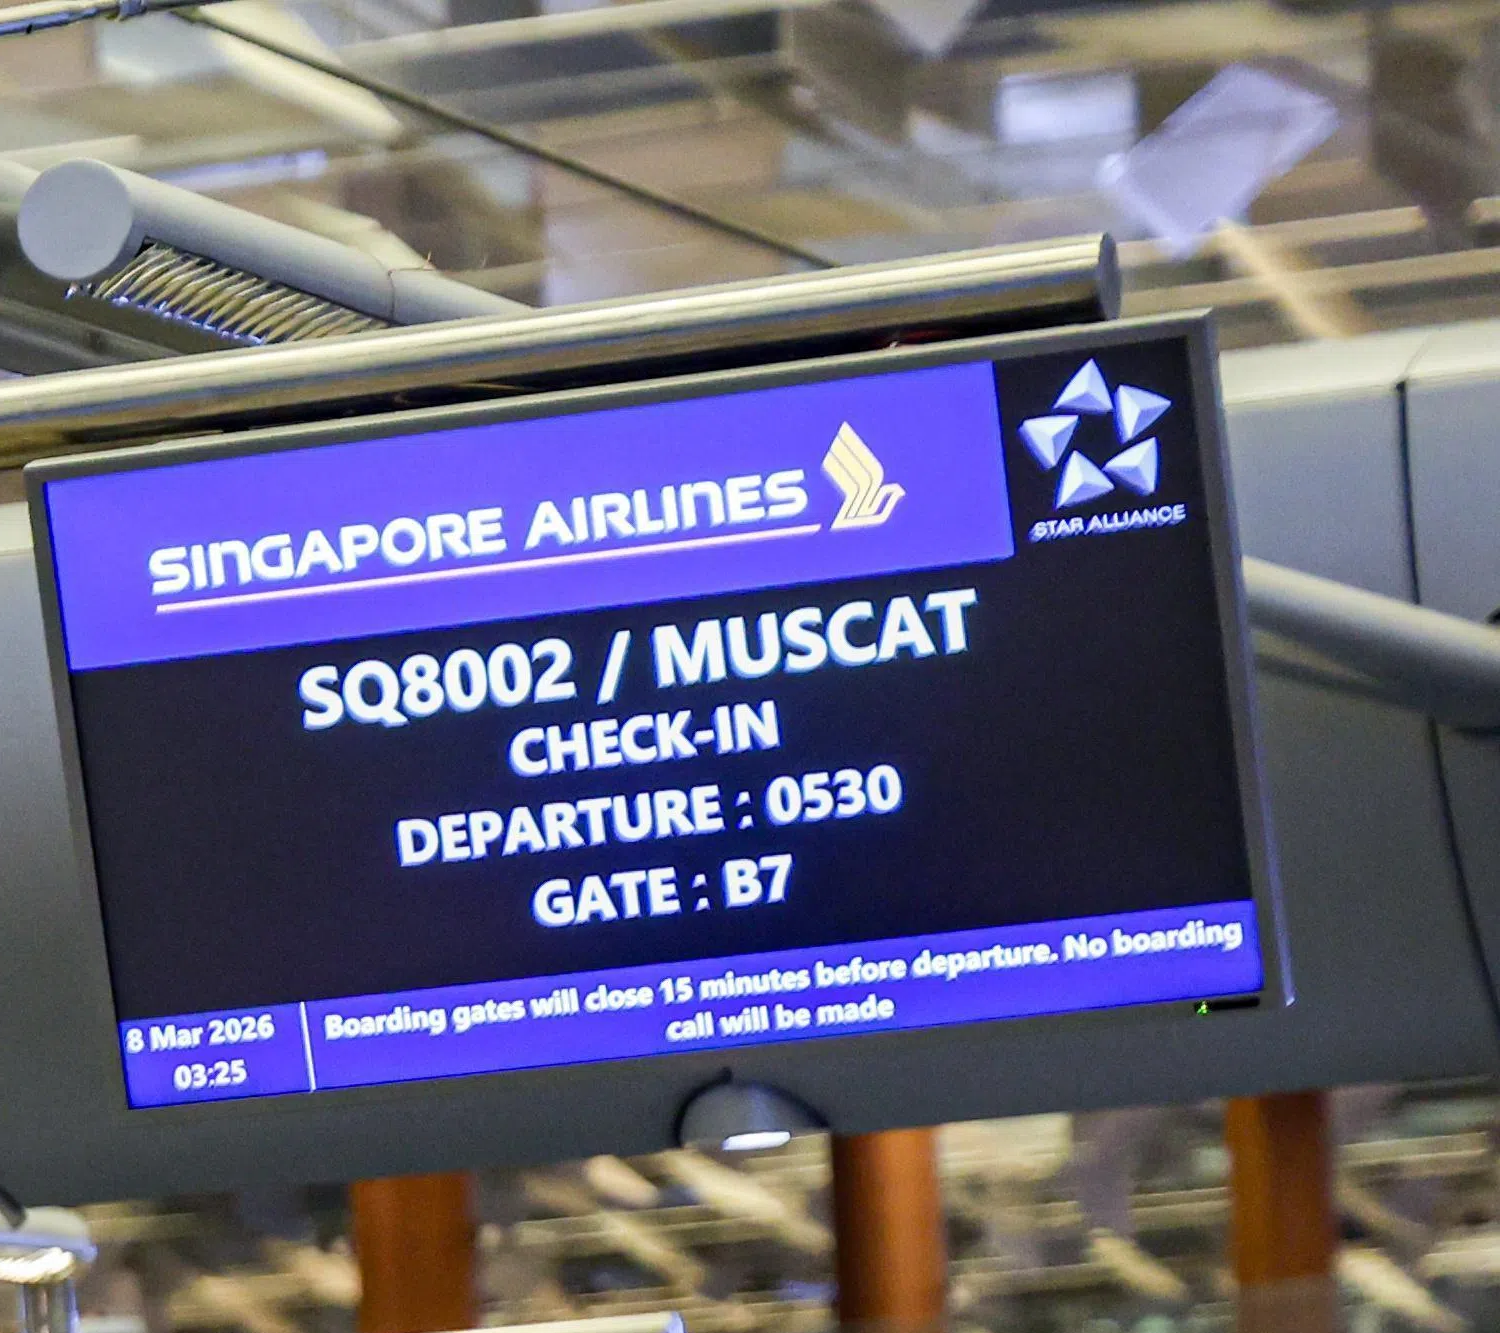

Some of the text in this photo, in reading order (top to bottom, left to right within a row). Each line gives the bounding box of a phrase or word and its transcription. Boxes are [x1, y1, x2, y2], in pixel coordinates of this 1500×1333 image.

[148, 468, 808, 595] SINGAPORE AIRLINES
[1030, 502, 1186, 540] STAR ALLIANCE
[299, 587, 976, 729] SQ8002 / MUSCAT
[509, 699, 779, 776] CHECK-IN
[396, 763, 902, 867] DEPARTURE : 0530
[532, 852, 793, 927] GATE : B7
[323, 919, 1243, 1040] Boarding gates will close 15 minutes before departure. No boarding
[665, 992, 895, 1042] call will be made
[125, 1013, 275, 1054] 8 Mar 2026
[173, 1058, 247, 1090] 03:25
